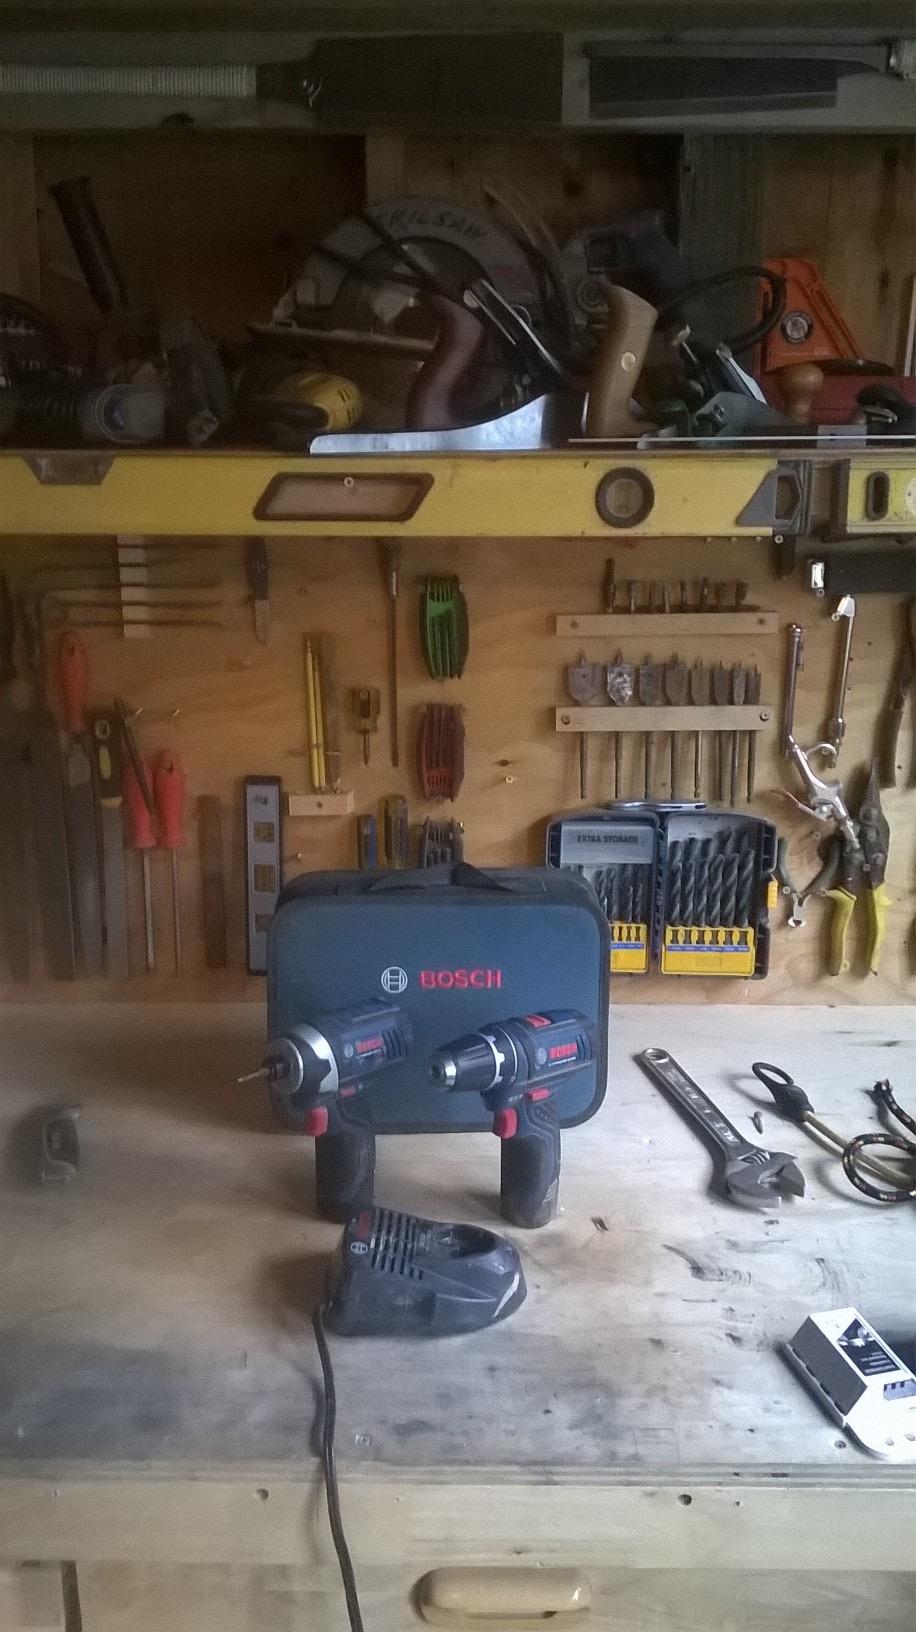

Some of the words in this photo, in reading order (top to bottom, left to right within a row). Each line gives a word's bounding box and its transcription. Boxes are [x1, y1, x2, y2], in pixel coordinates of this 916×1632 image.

[577, 834, 601, 843] EXTRA
[603, 834, 639, 843] STORAGE
[420, 968, 502, 989] BOSCH
